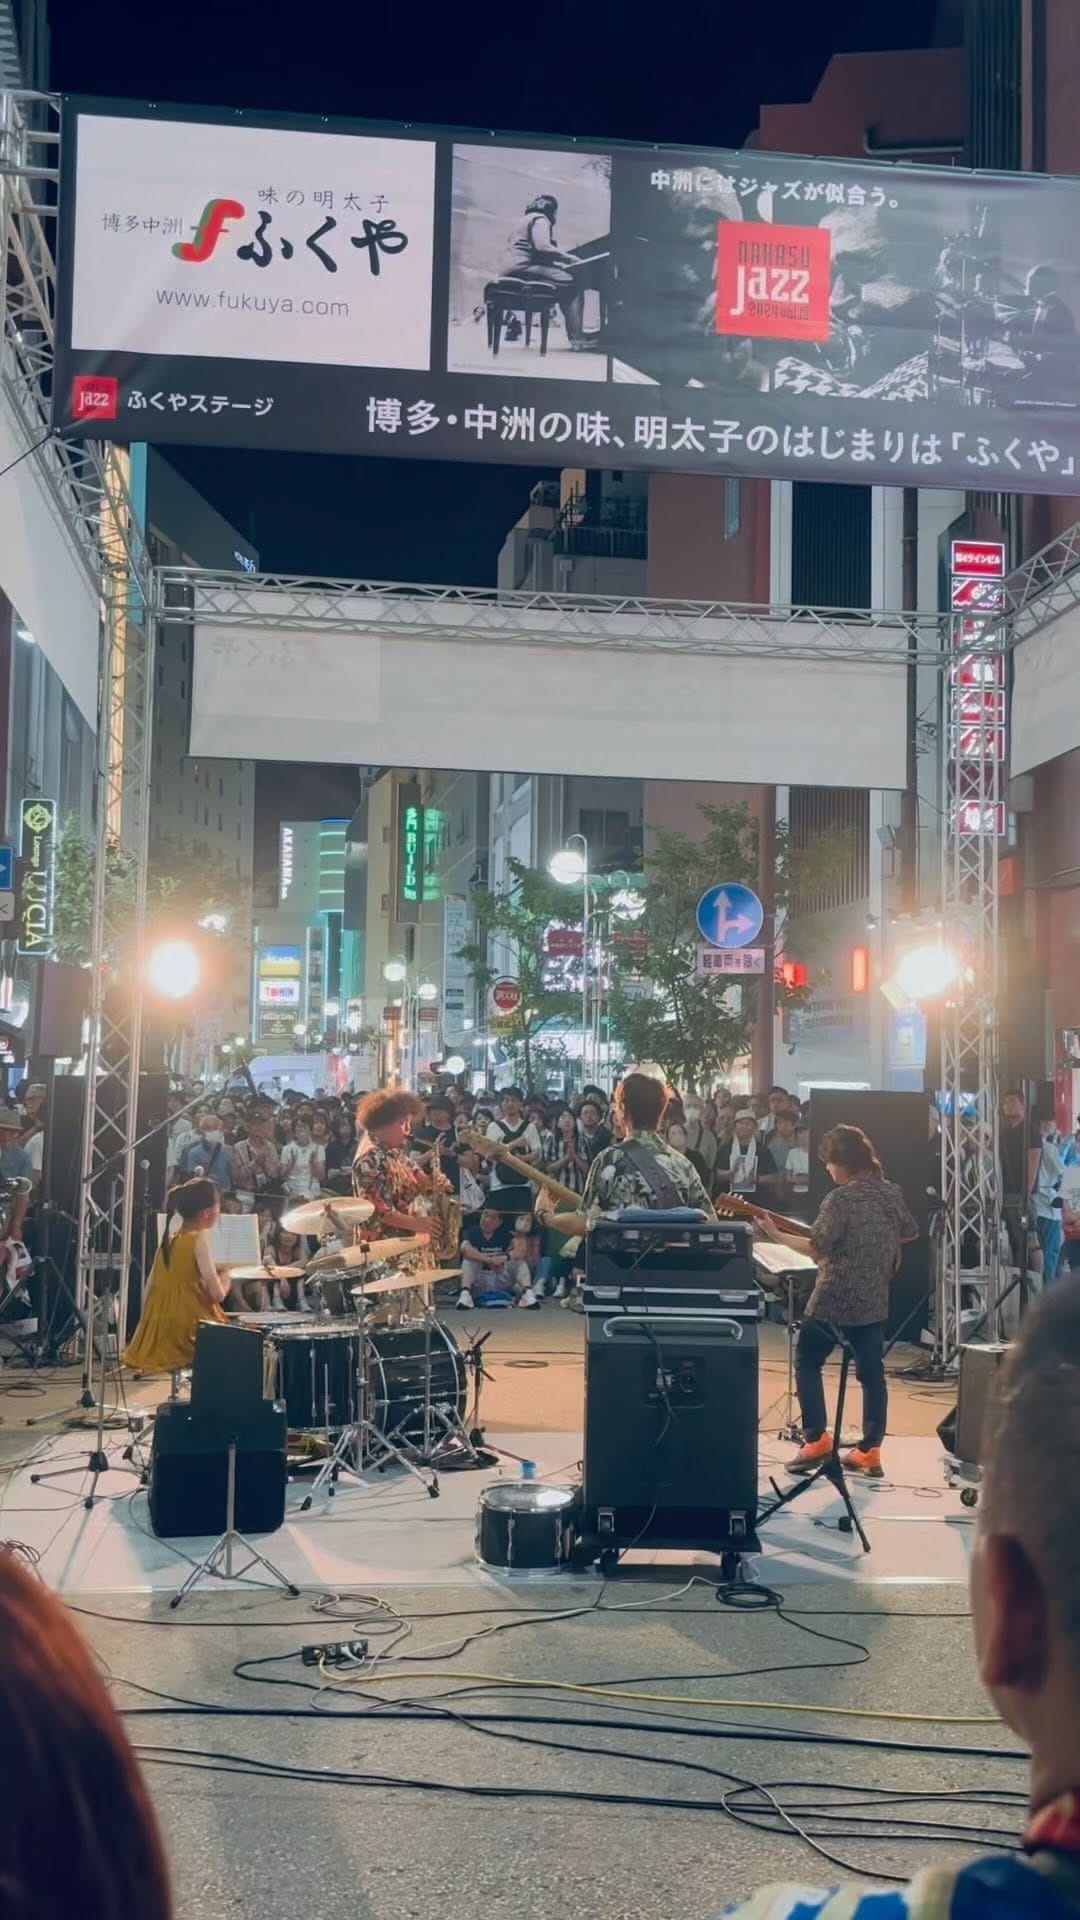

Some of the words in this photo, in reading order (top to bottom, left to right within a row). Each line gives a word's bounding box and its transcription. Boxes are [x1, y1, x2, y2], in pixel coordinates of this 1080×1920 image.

[257, 187, 390, 214] 味の明太子
[651, 169, 898, 208] 中洲にはジャズが似合う。
[102, 212, 184, 236] 博多中洲
[236, 210, 409, 276] ふくや
[738, 241, 811, 268] NAKASU
[156, 288, 350, 317] www.fukuya.com
[730, 265, 810, 316] jazz
[127, 390, 274, 416] ふくやステージ
